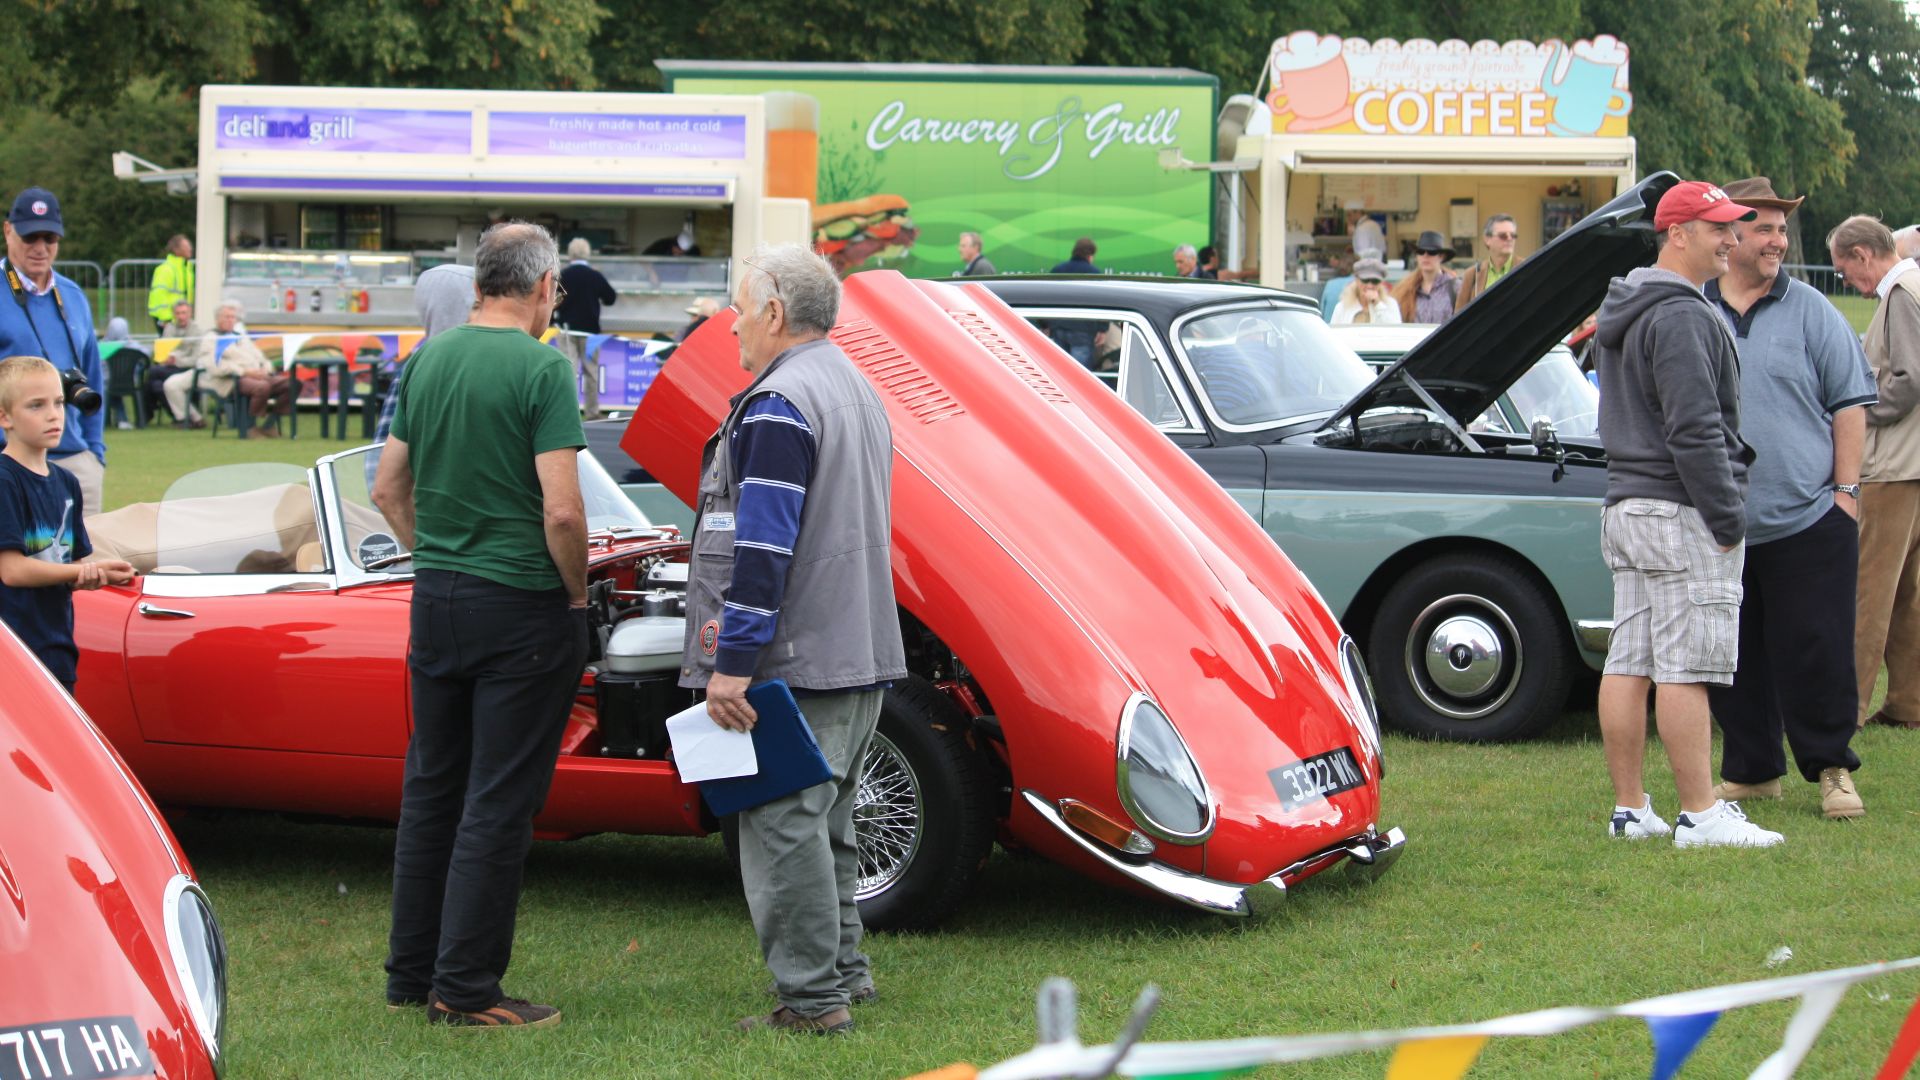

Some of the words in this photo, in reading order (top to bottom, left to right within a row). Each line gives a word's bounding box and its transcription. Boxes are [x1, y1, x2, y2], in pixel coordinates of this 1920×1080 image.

[549, 118, 593, 132] freshly
[597, 119, 634, 131] made
[638, 120, 660, 132] hot
[664, 120, 688, 132] and
[692, 120, 721, 132] cold
[866, 100, 1020, 156] Carvery
[1083, 102, 1181, 159] Grill
[1354, 90, 1547, 135] COFFEE
[1282, 758, 1338, 802] 3322
[1328, 751, 1359, 786] WK
[0, 1028, 73, 1080] 717
[79, 1024, 142, 1073] HA
